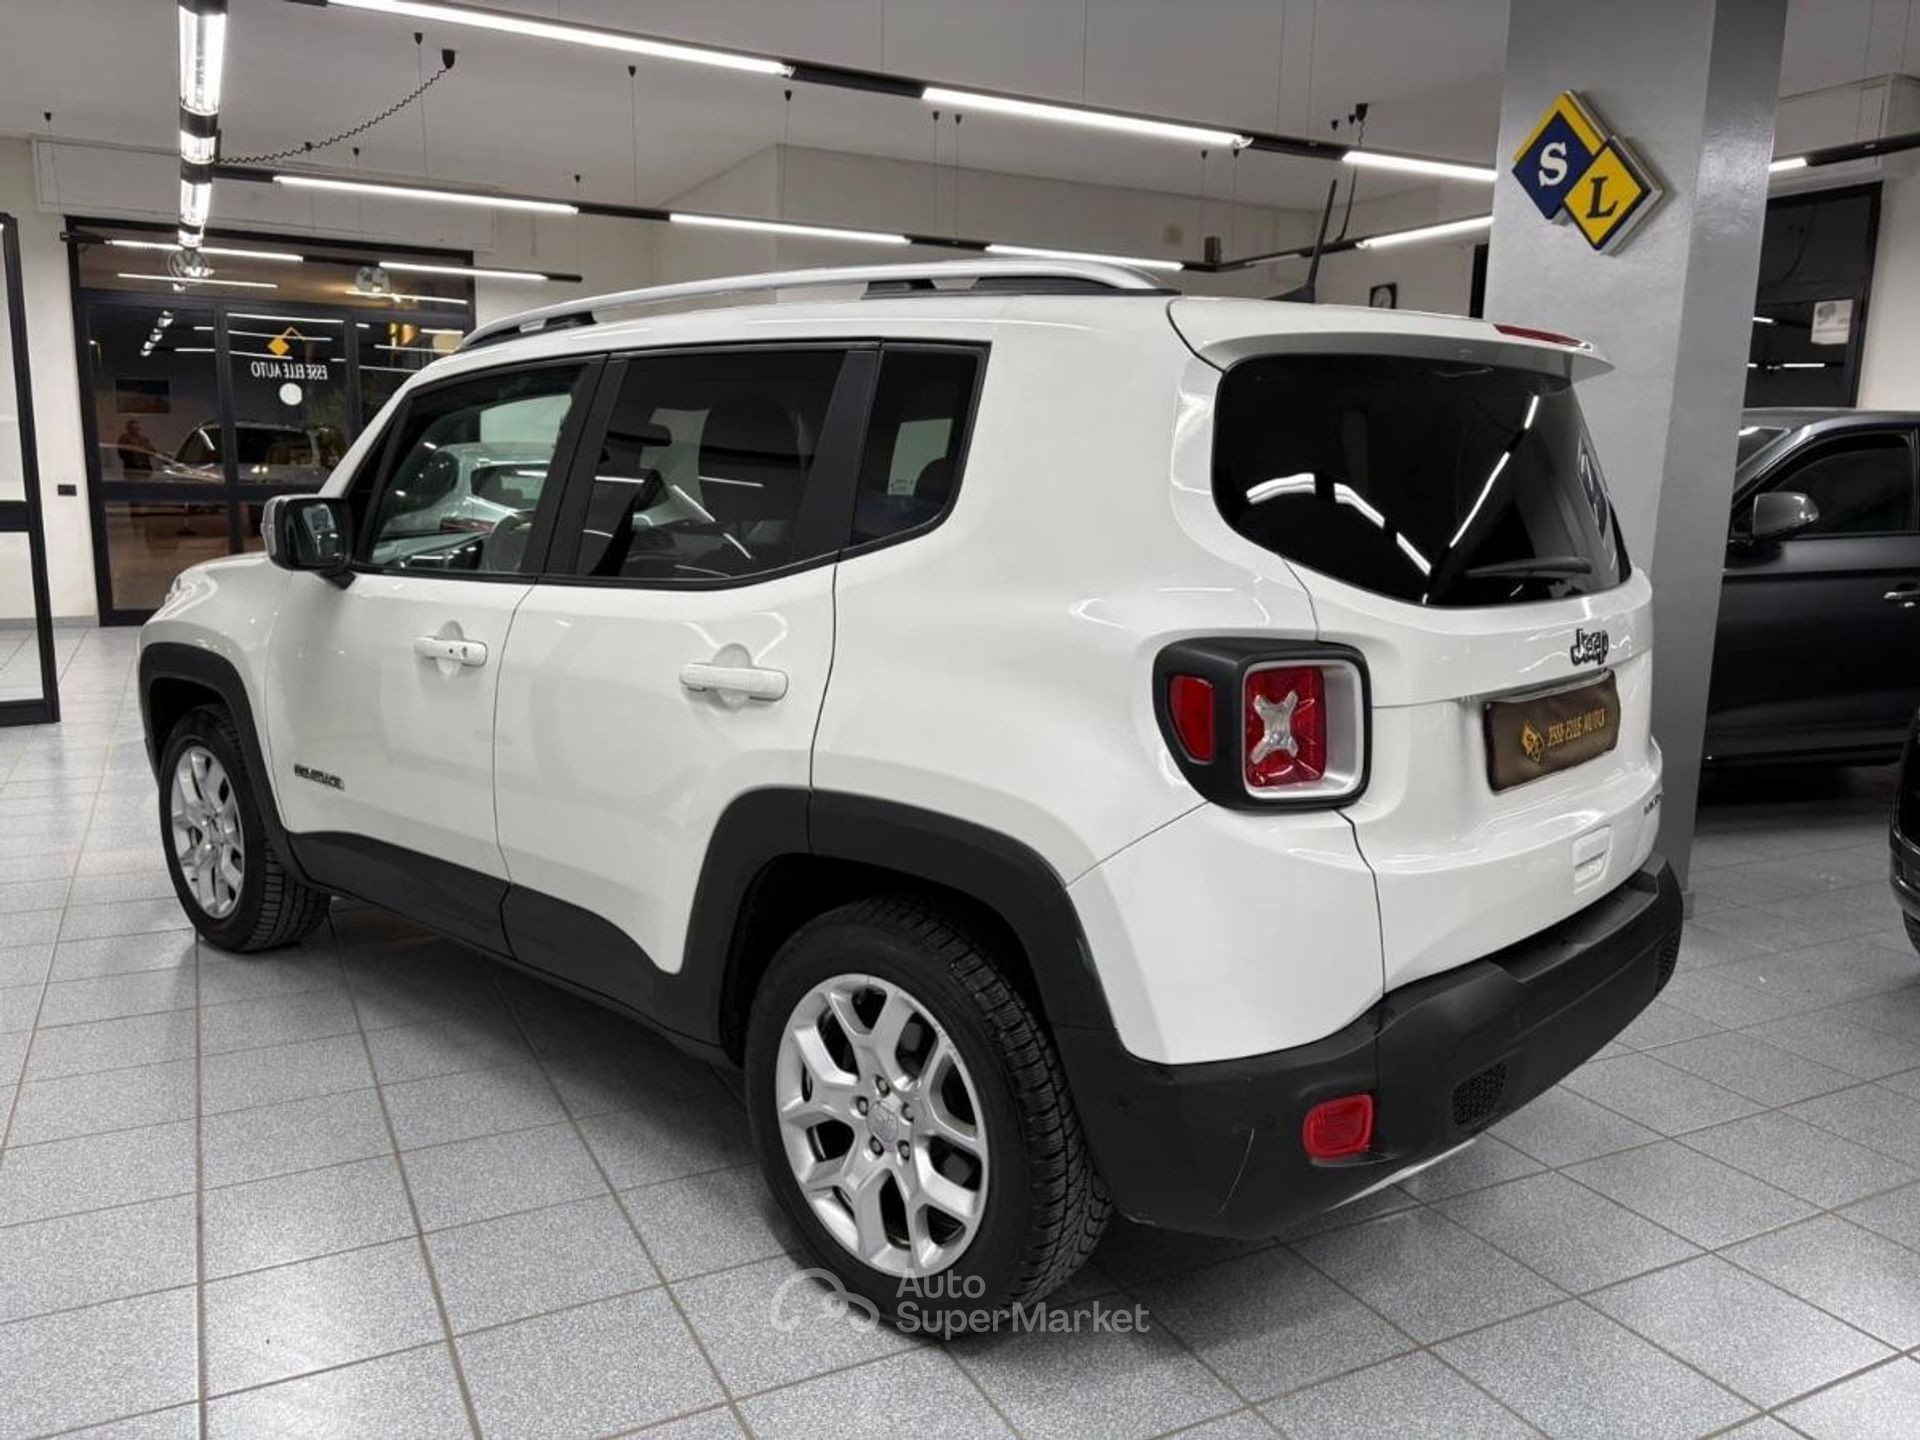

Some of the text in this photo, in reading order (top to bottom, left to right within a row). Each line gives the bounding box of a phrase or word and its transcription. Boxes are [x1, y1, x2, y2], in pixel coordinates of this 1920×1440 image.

[1538, 141, 1619, 219] S L
[1570, 628, 1609, 666] Jeep
